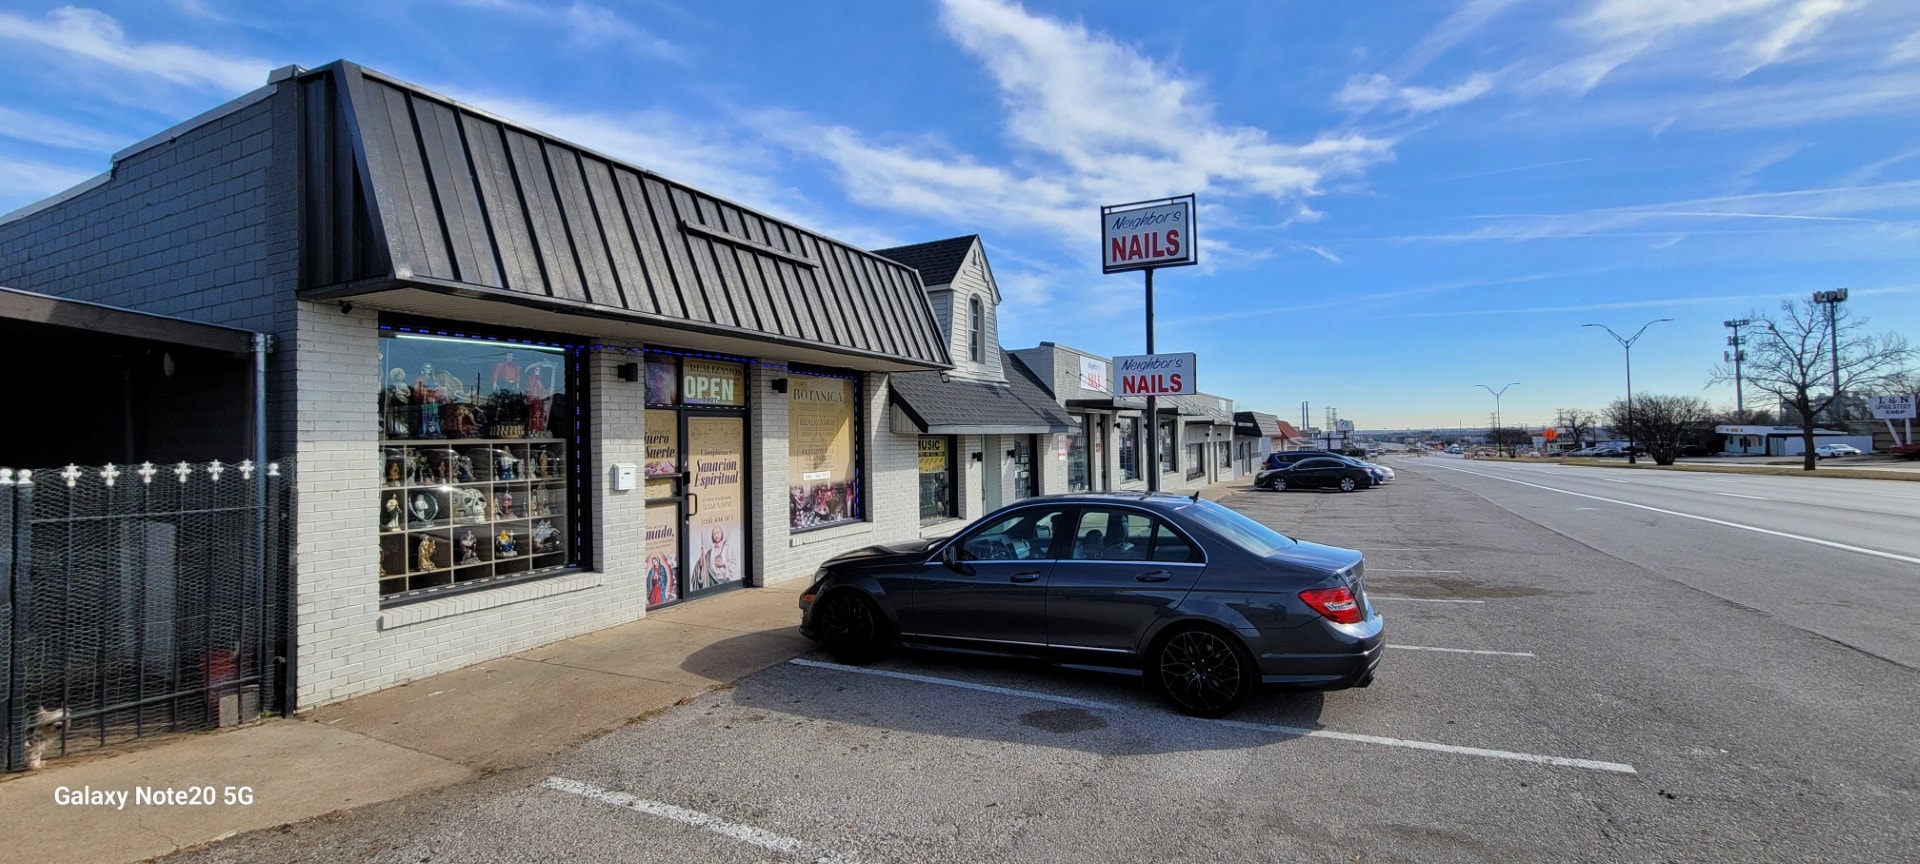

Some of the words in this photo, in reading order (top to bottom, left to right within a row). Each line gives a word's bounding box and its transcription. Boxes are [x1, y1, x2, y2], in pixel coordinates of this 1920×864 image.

[1112, 210, 1182, 231] Neighbor's
[1111, 229, 1180, 262] NAILS
[690, 363, 743, 376] REALIZAMOS
[1121, 357, 1183, 372] Neighbor's
[684, 375, 734, 401] OPEN
[1122, 373, 1183, 394] NAILS
[793, 388, 843, 403] BOTANICA
[646, 445, 675, 458] Suerte
[694, 471, 739, 489] Espiritual
